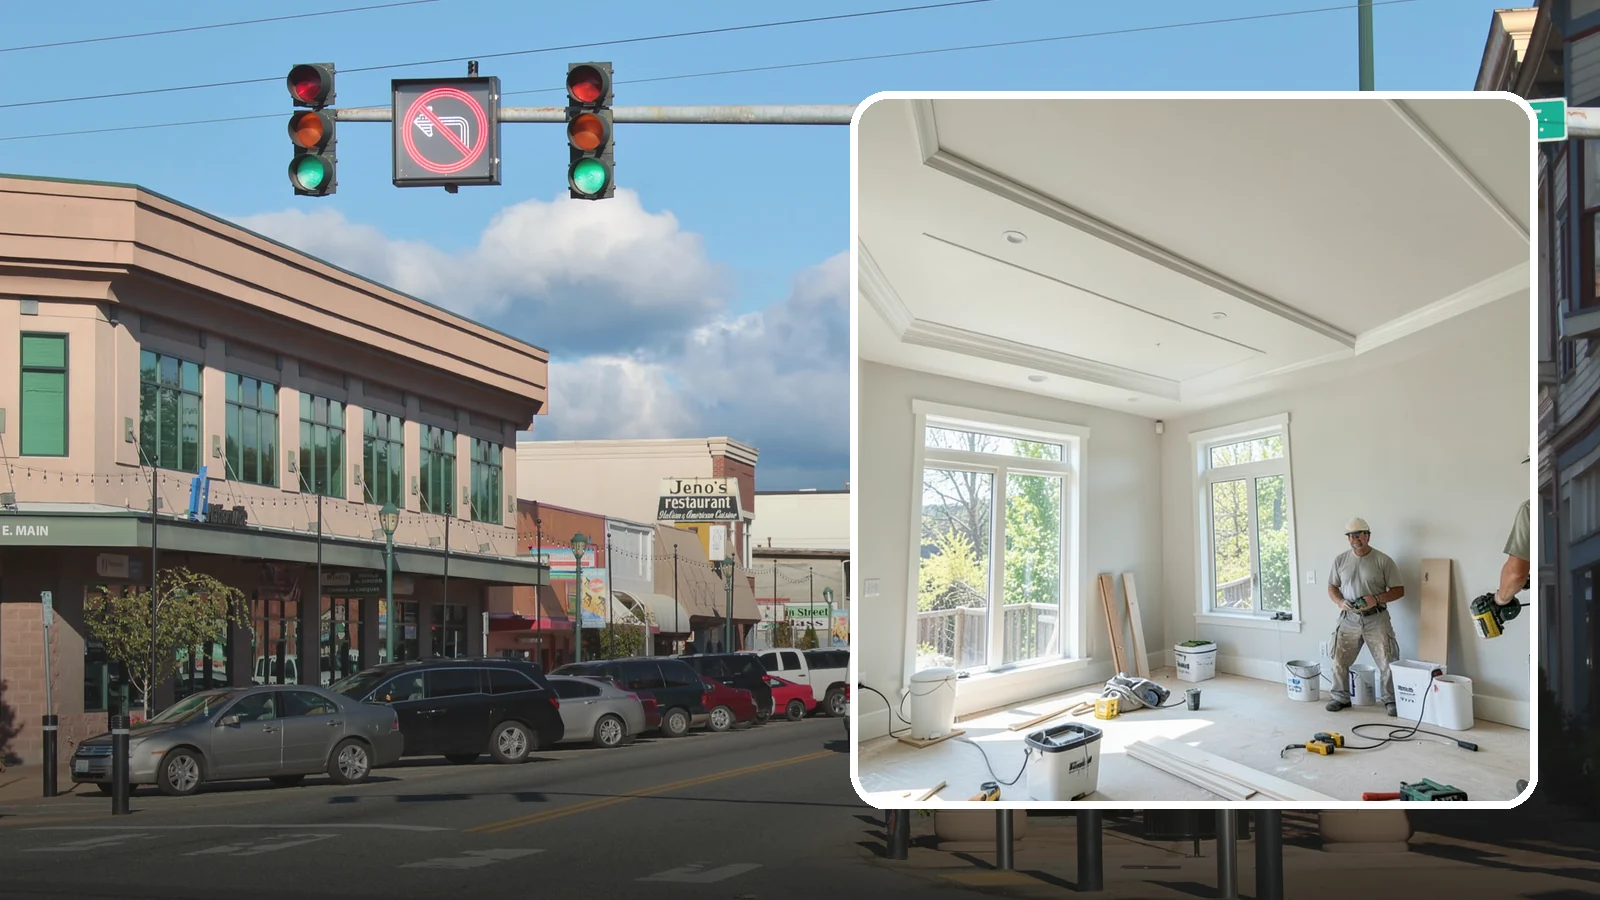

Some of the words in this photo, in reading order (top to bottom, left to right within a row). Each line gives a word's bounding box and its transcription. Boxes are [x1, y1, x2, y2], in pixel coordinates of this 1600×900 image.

[670, 480, 728, 494] Jeno's
[665, 496, 731, 509] restaurant
[658, 510, 681, 520] Italian
[686, 509, 714, 520] American
[715, 509, 738, 519] Cuisine
[2, 525, 13, 536] E.
[15, 525, 49, 536] MAIN
[797, 607, 828, 617] Street
